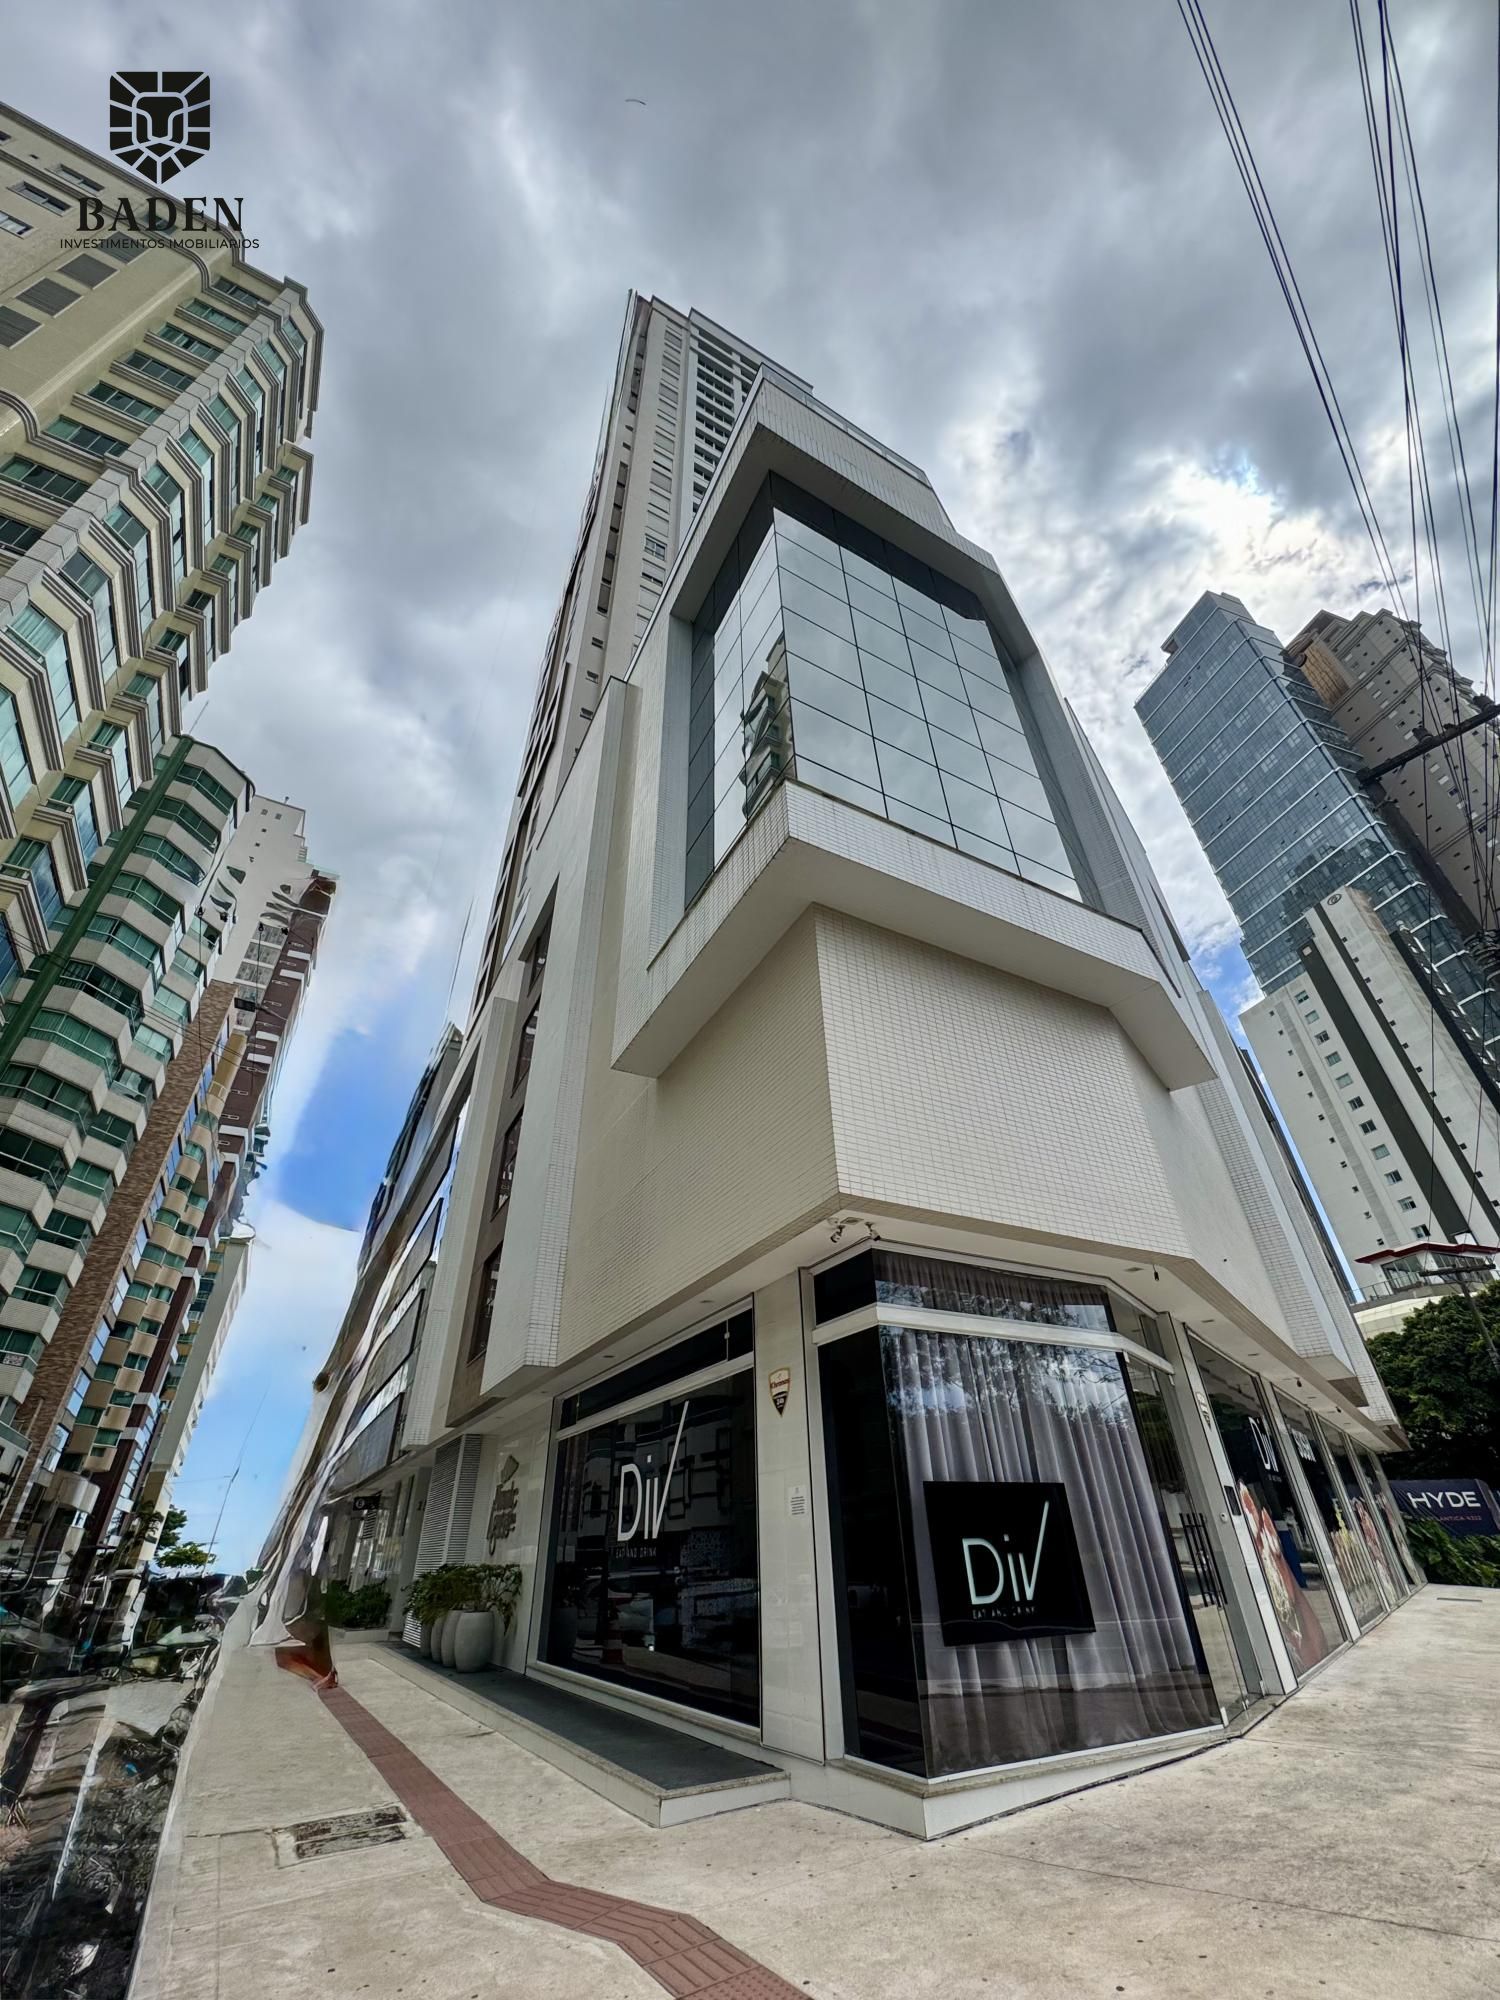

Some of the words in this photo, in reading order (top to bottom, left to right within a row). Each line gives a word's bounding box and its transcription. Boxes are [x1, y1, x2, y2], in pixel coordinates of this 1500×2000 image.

[1407, 1491, 1481, 1509] HYDE
[962, 1500, 1050, 1606] Div
[972, 1608, 986, 1620] EAT
